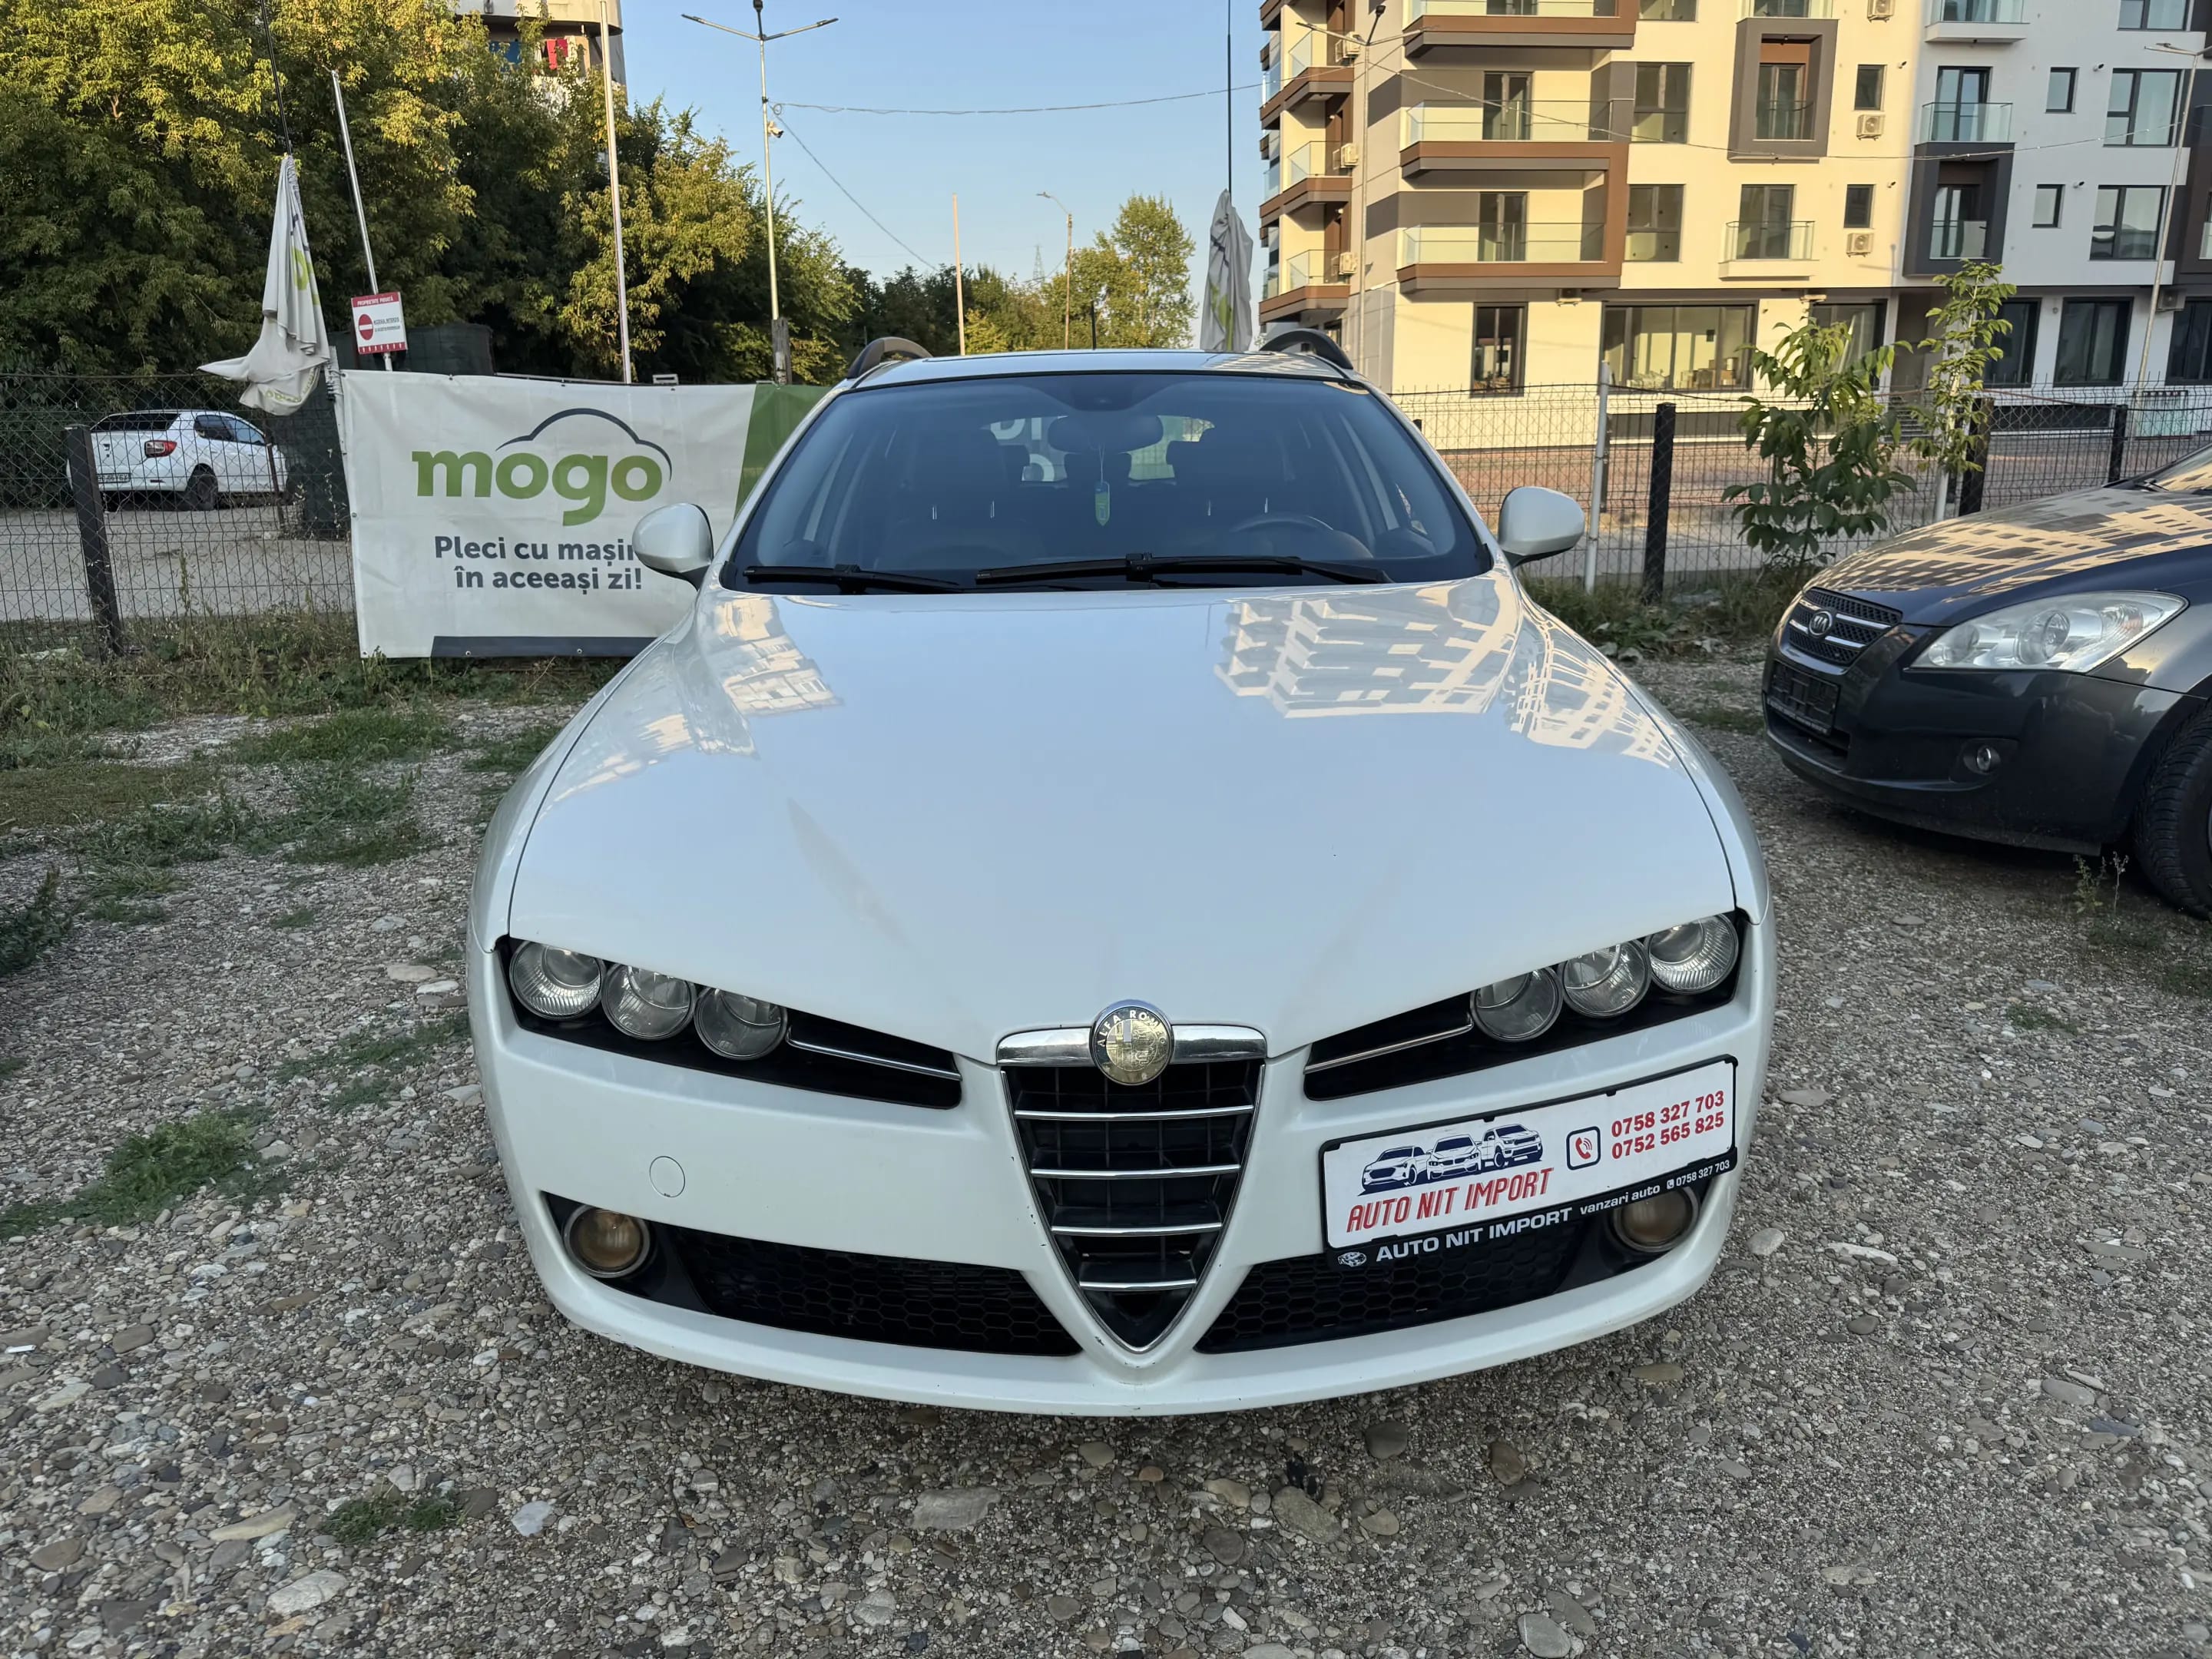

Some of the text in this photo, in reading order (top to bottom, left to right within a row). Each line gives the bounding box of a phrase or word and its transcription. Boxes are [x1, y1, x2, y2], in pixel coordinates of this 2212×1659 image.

[412, 450, 662, 526] mogo
[435, 535, 506, 559] Pleci
[514, 542, 548, 560] cu
[454, 565, 642, 594] în aceeași zi!
[1097, 1010, 1167, 1048] ALFA ROMEO
[1611, 1090, 1724, 1137] 0758 327 703
[1611, 1111, 1724, 1159] 0752 565 825
[1346, 1167, 1554, 1233] AUTO NIT IMPORT
[1376, 1160, 1730, 1262] AUTO NIT IMPORT vanzari auto 0758 327 703
